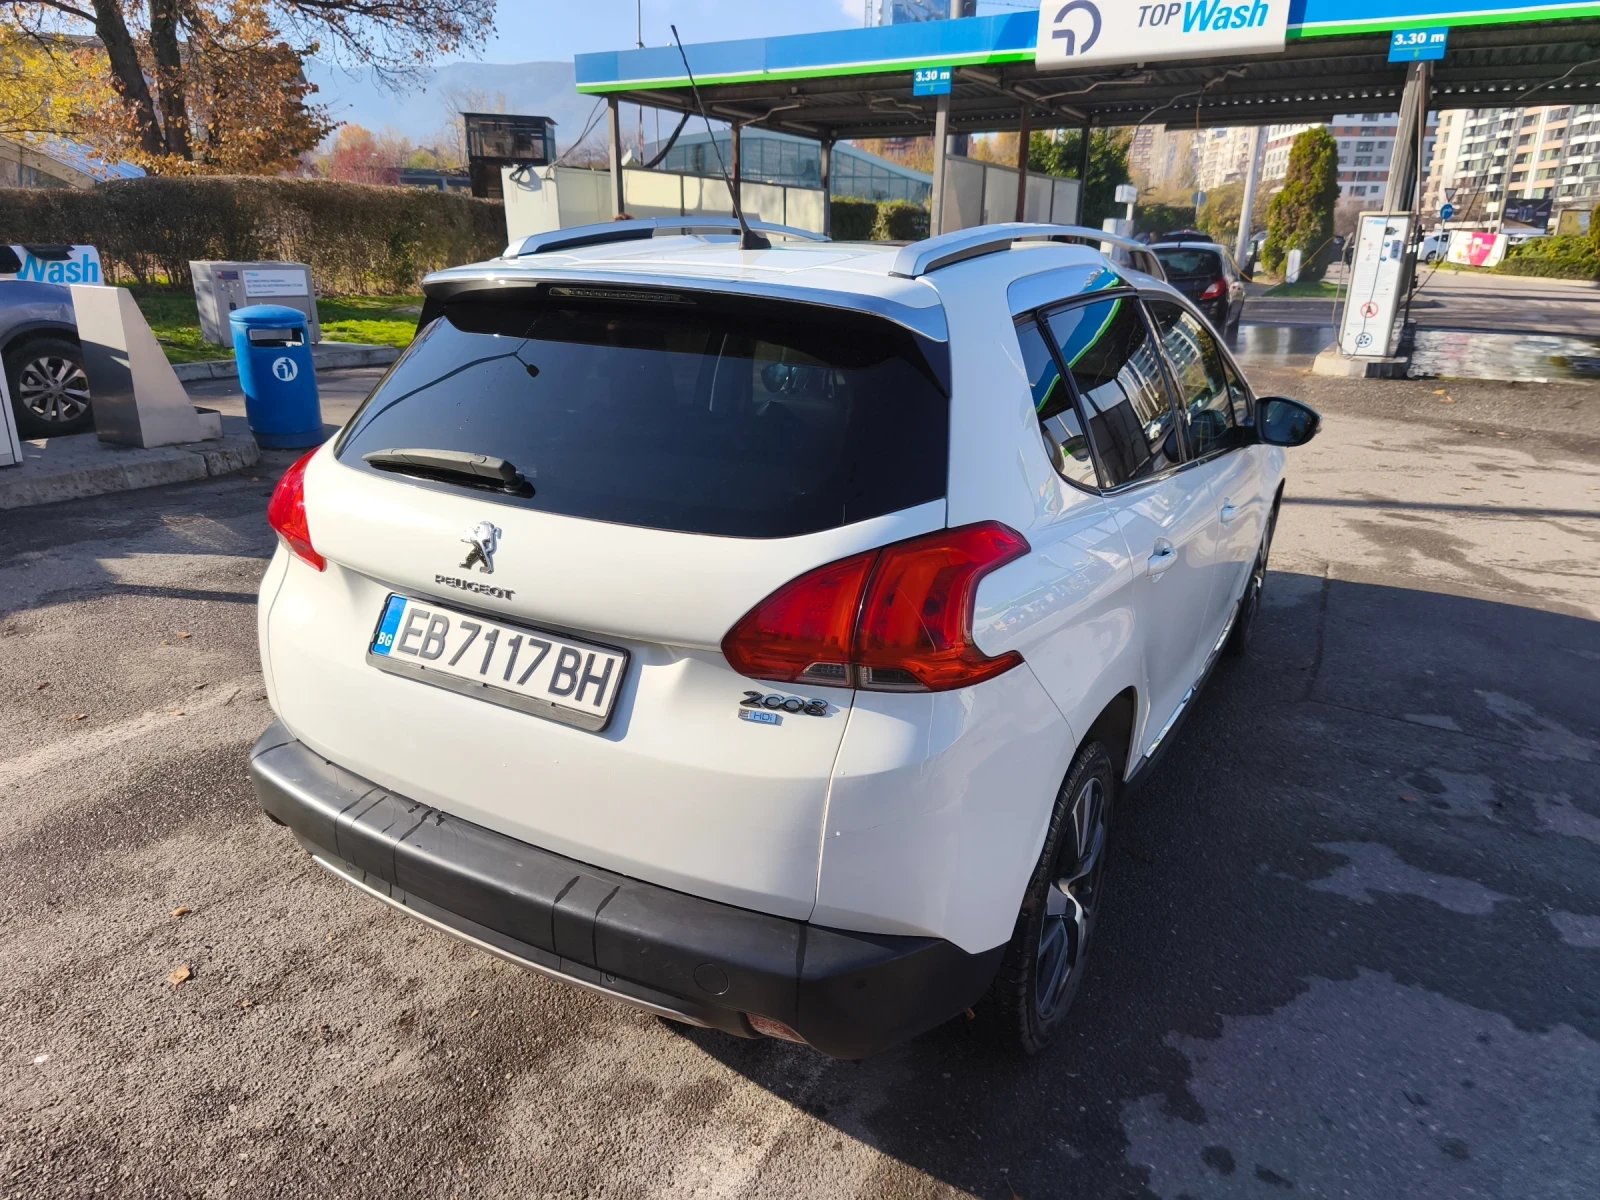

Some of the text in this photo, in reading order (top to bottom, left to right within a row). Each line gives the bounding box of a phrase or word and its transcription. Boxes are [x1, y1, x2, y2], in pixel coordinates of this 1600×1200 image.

[1393, 32, 1445, 46] 3.30 m
[915, 70, 950, 82] 3.30 m
[16, 253, 99, 284] Wash
[435, 574, 516, 601] PEUGEOT
[377, 632, 393, 647] BG
[739, 690, 829, 717] 2008
